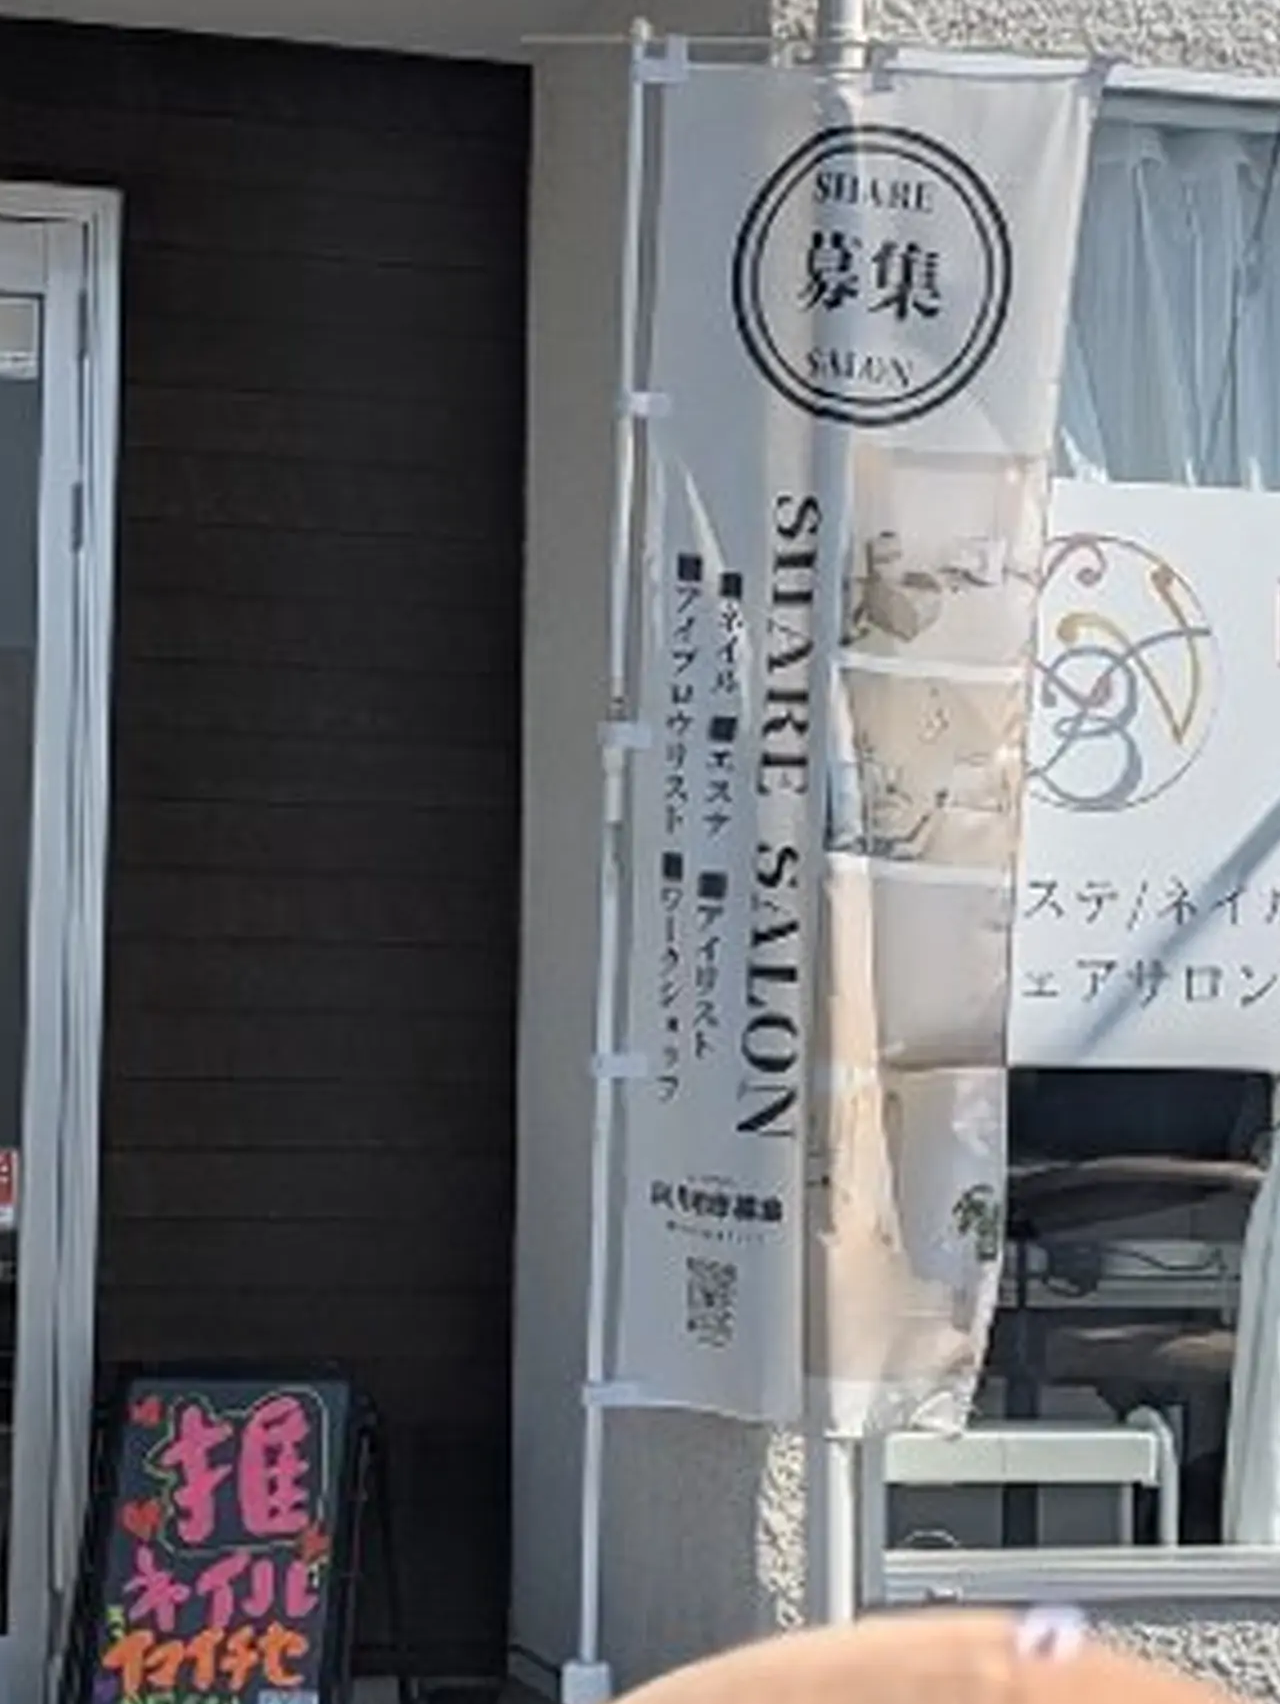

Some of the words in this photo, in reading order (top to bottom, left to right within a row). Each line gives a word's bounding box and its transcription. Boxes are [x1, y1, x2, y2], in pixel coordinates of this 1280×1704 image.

[815, 170, 934, 215] SHARE
[799, 230, 942, 322] 募集
[806, 345, 916, 390] SALON
[757, 494, 823, 796] SHARE
[736, 842, 802, 1139] SALON
[161, 1396, 310, 1544] 推
[125, 1545, 319, 1631] ネイル
